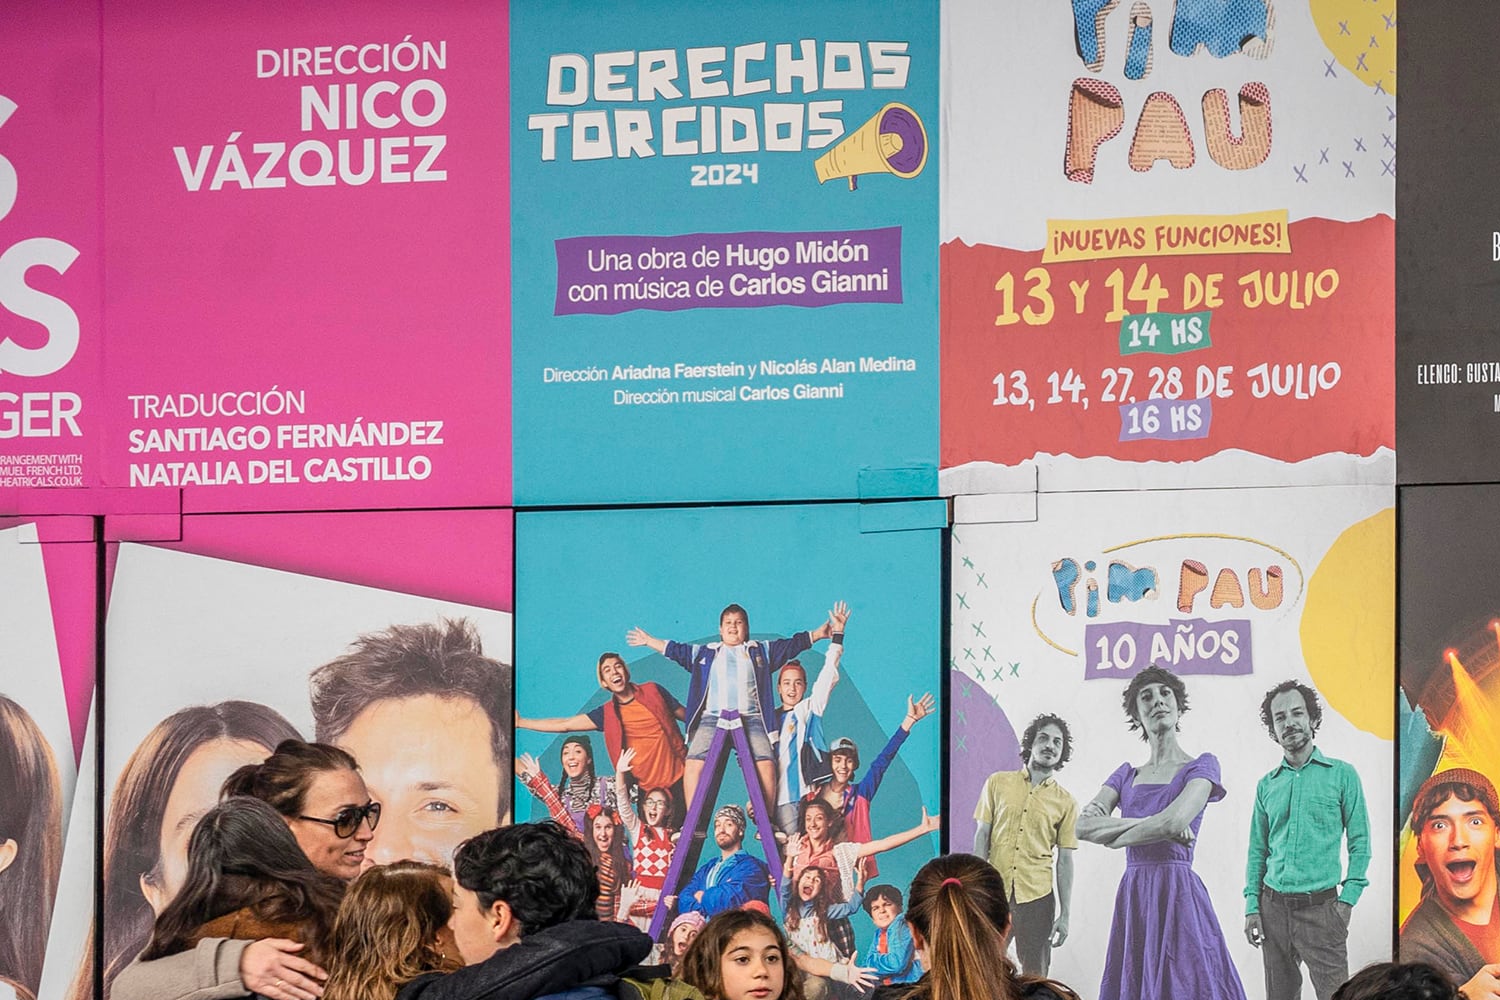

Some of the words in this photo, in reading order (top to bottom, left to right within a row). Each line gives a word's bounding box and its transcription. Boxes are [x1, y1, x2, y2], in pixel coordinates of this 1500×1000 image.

[257, 36, 447, 78] DIRECCIÓN
[546, 39, 911, 107] DERECHOS
[300, 79, 447, 131] NICO
[528, 100, 845, 161] TORCIDOS
[1064, 77, 1272, 184] PAU
[173, 132, 448, 192] VÁZQUEZ
[691, 164, 758, 186] 2024
[1053, 225, 1145, 255] ¡NUEVAS
[1155, 222, 1282, 249] FUNCIONES!
[588, 249, 633, 272] Una
[638, 246, 687, 270] obra
[692, 245, 719, 268] de
[726, 242, 789, 274] Hugo
[796, 239, 869, 264] Midón
[568, 283, 608, 303] con
[614, 277, 690, 301] música
[696, 275, 723, 297] de
[729, 272, 805, 296] Carlos
[812, 269, 888, 293] Gianni
[994, 267, 1055, 326] 13
[1070, 280, 1090, 314] Y
[1104, 264, 1169, 323] 14
[1184, 273, 1224, 309] DE
[1238, 269, 1339, 309] JULIO
[1128, 319, 1160, 347] 14
[1172, 317, 1203, 345] HS
[543, 367, 608, 383] Dirección
[612, 364, 671, 381] Ariadna
[674, 362, 744, 379] Faerstein
[749, 365, 756, 380] y
[760, 360, 817, 376] Nicolás
[820, 358, 856, 374] Alan
[859, 357, 916, 372] Medina
[992, 370, 1035, 411] 13,
[1047, 368, 1089, 409] 14,
[1101, 368, 1134, 402] 27,
[1148, 367, 1184, 400] 28
[1196, 365, 1234, 398] DE
[1246, 362, 1342, 400] JULIO
[1418, 364, 1462, 384] ELENCO:
[128, 385, 305, 419] TRADUCCIÓN
[614, 389, 679, 405] Dirección
[683, 387, 736, 403] musical
[739, 386, 789, 401] Carlos
[793, 384, 843, 399] Gianni
[0, 391, 83, 439] GER
[1127, 406, 1160, 434] 16
[1171, 403, 1203, 431] HS
[128, 426, 271, 453] SANTIAGO
[277, 418, 444, 449] FERNÁNDEZ
[0, 455, 57, 465] RANGEMENT
[59, 454, 83, 464] WITH
[0, 466, 25, 476] MUEL
[26, 466, 62, 475] FRENCH
[64, 465, 83, 475] LTD.
[129, 460, 243, 488] NATALIA
[259, 458, 299, 484] DEL
[304, 456, 432, 482] CASTILLO
[0, 476, 83, 487] HEATRICALS.CO.UK
[1177, 559, 1284, 614] PAU
[1095, 635, 1136, 670] 10
[1151, 623, 1240, 665] AÑOS
